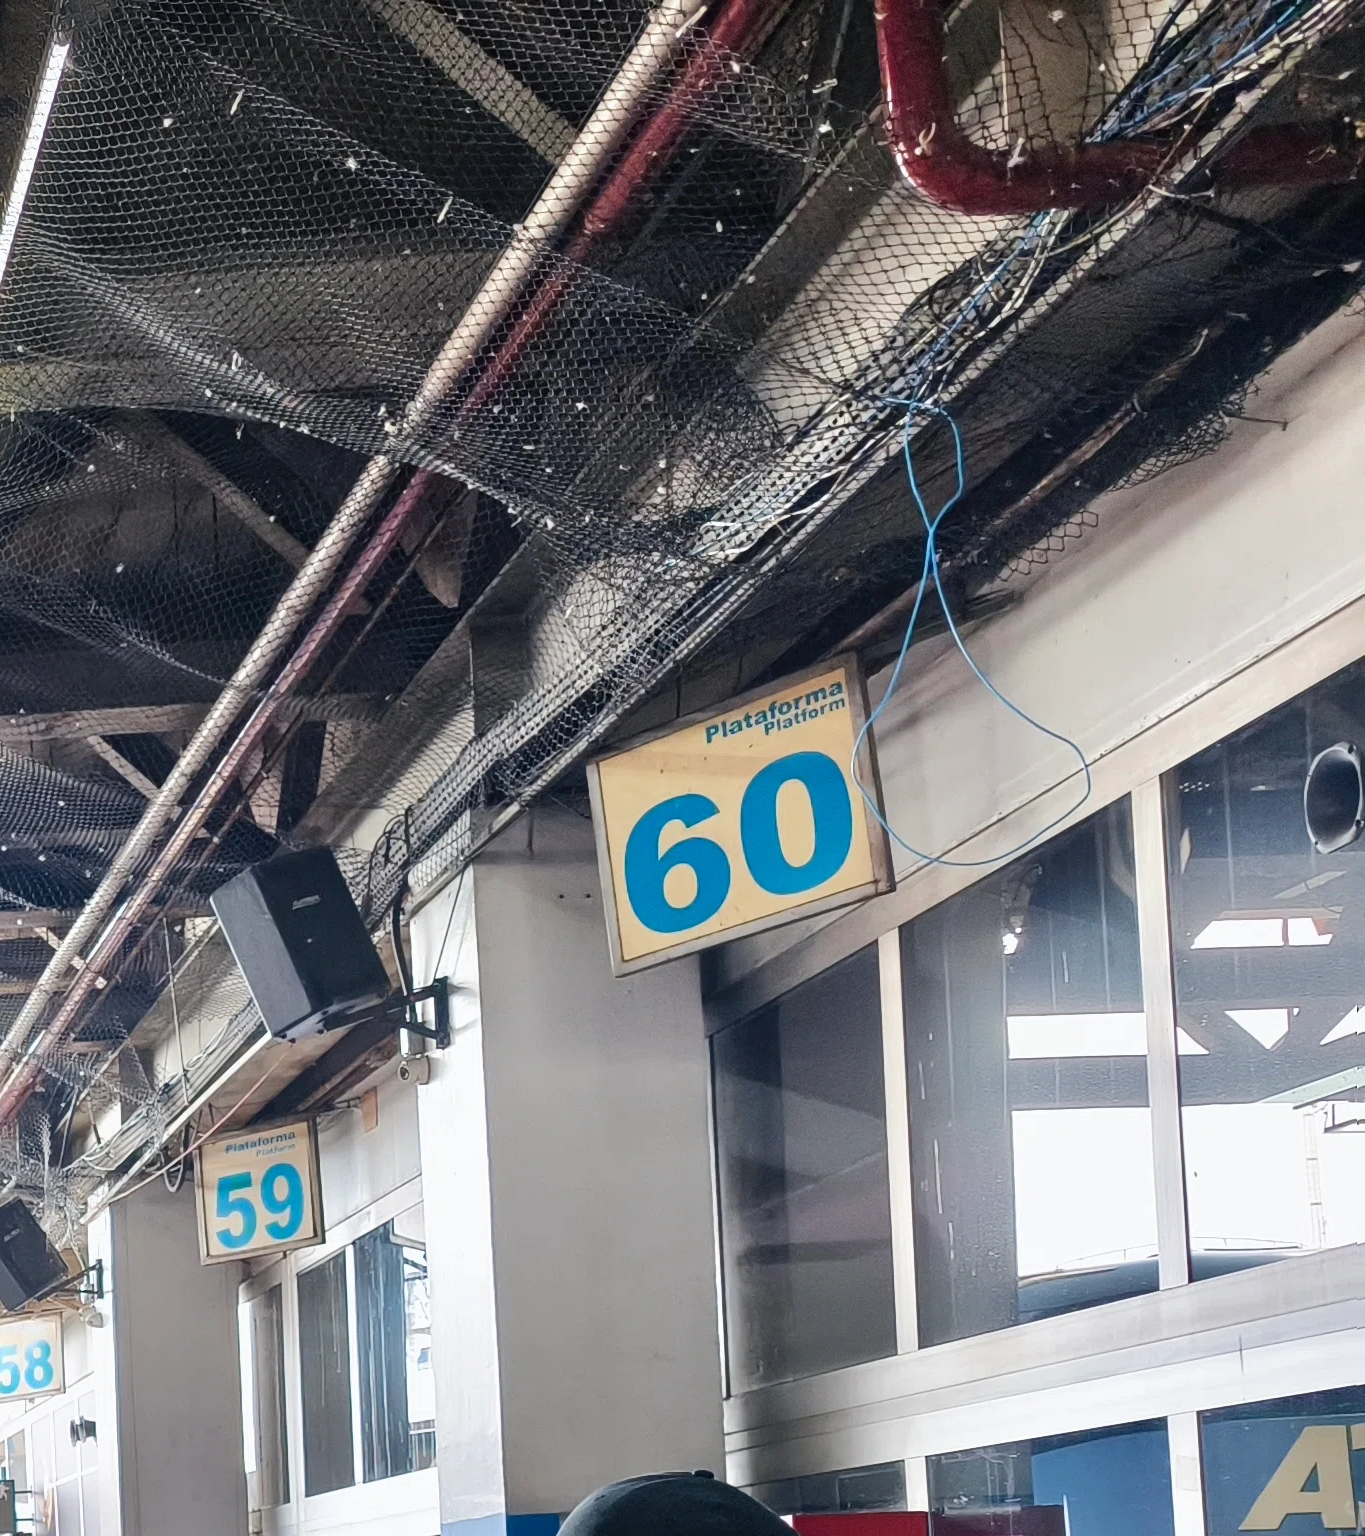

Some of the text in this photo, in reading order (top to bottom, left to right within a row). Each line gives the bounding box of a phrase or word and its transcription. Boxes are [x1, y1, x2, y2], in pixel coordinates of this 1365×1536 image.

[705, 680, 844, 744] Plataforma
[763, 697, 846, 736] Platform
[624, 751, 853, 935] 60
[225, 1131, 296, 1154] Plataforma
[216, 1163, 305, 1250] 59
[1237, 1422, 1365, 1531] A
